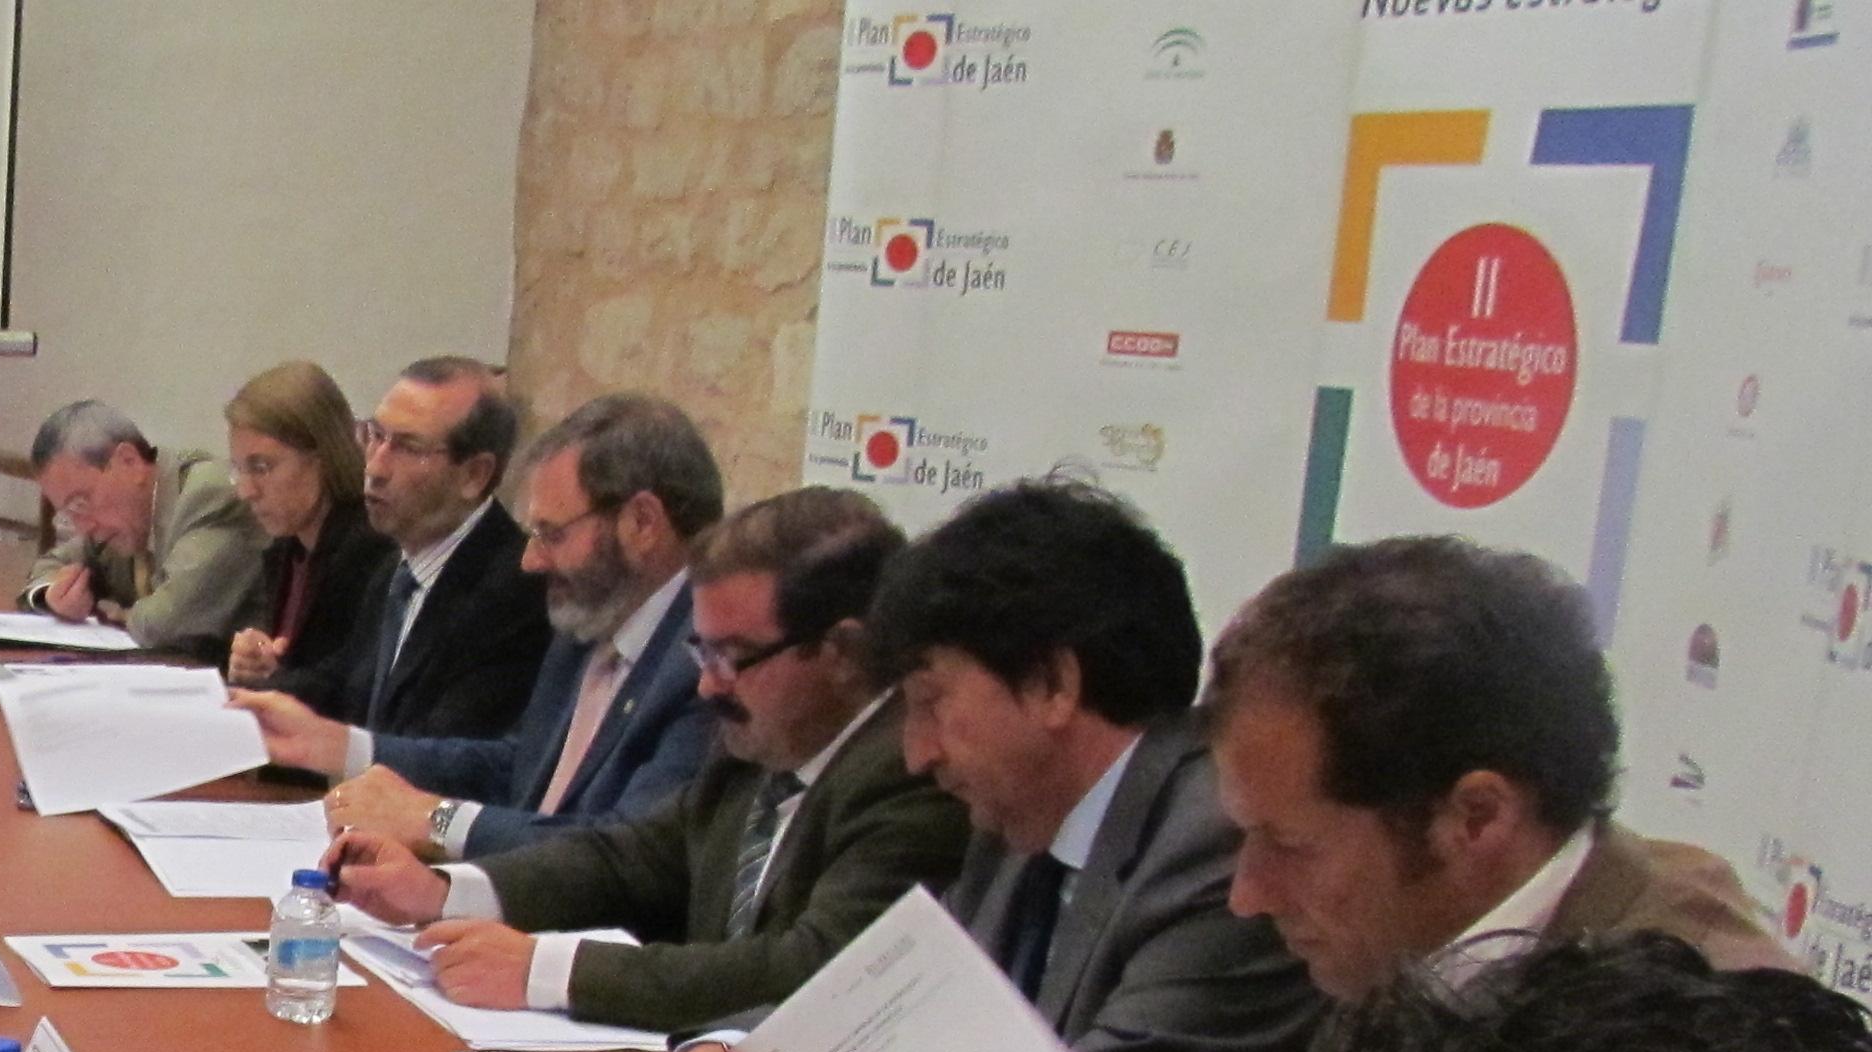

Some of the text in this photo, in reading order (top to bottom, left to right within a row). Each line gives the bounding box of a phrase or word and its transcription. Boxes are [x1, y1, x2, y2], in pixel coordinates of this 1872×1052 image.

[859, 17, 889, 46] Plan
[957, 21, 1031, 48] Estratégico
[953, 54, 1028, 92] de Jaén
[840, 216, 872, 245] Plan
[936, 228, 1010, 256] Estratégico
[933, 259, 1006, 297] de Jaén
[1471, 254, 1502, 319] II
[1398, 321, 1568, 386] Plan Estratégico
[821, 411, 853, 441] Plan
[1408, 382, 1540, 434] de la provincia
[914, 458, 985, 495] de Jaén
[1426, 440, 1502, 493] de Jaén
